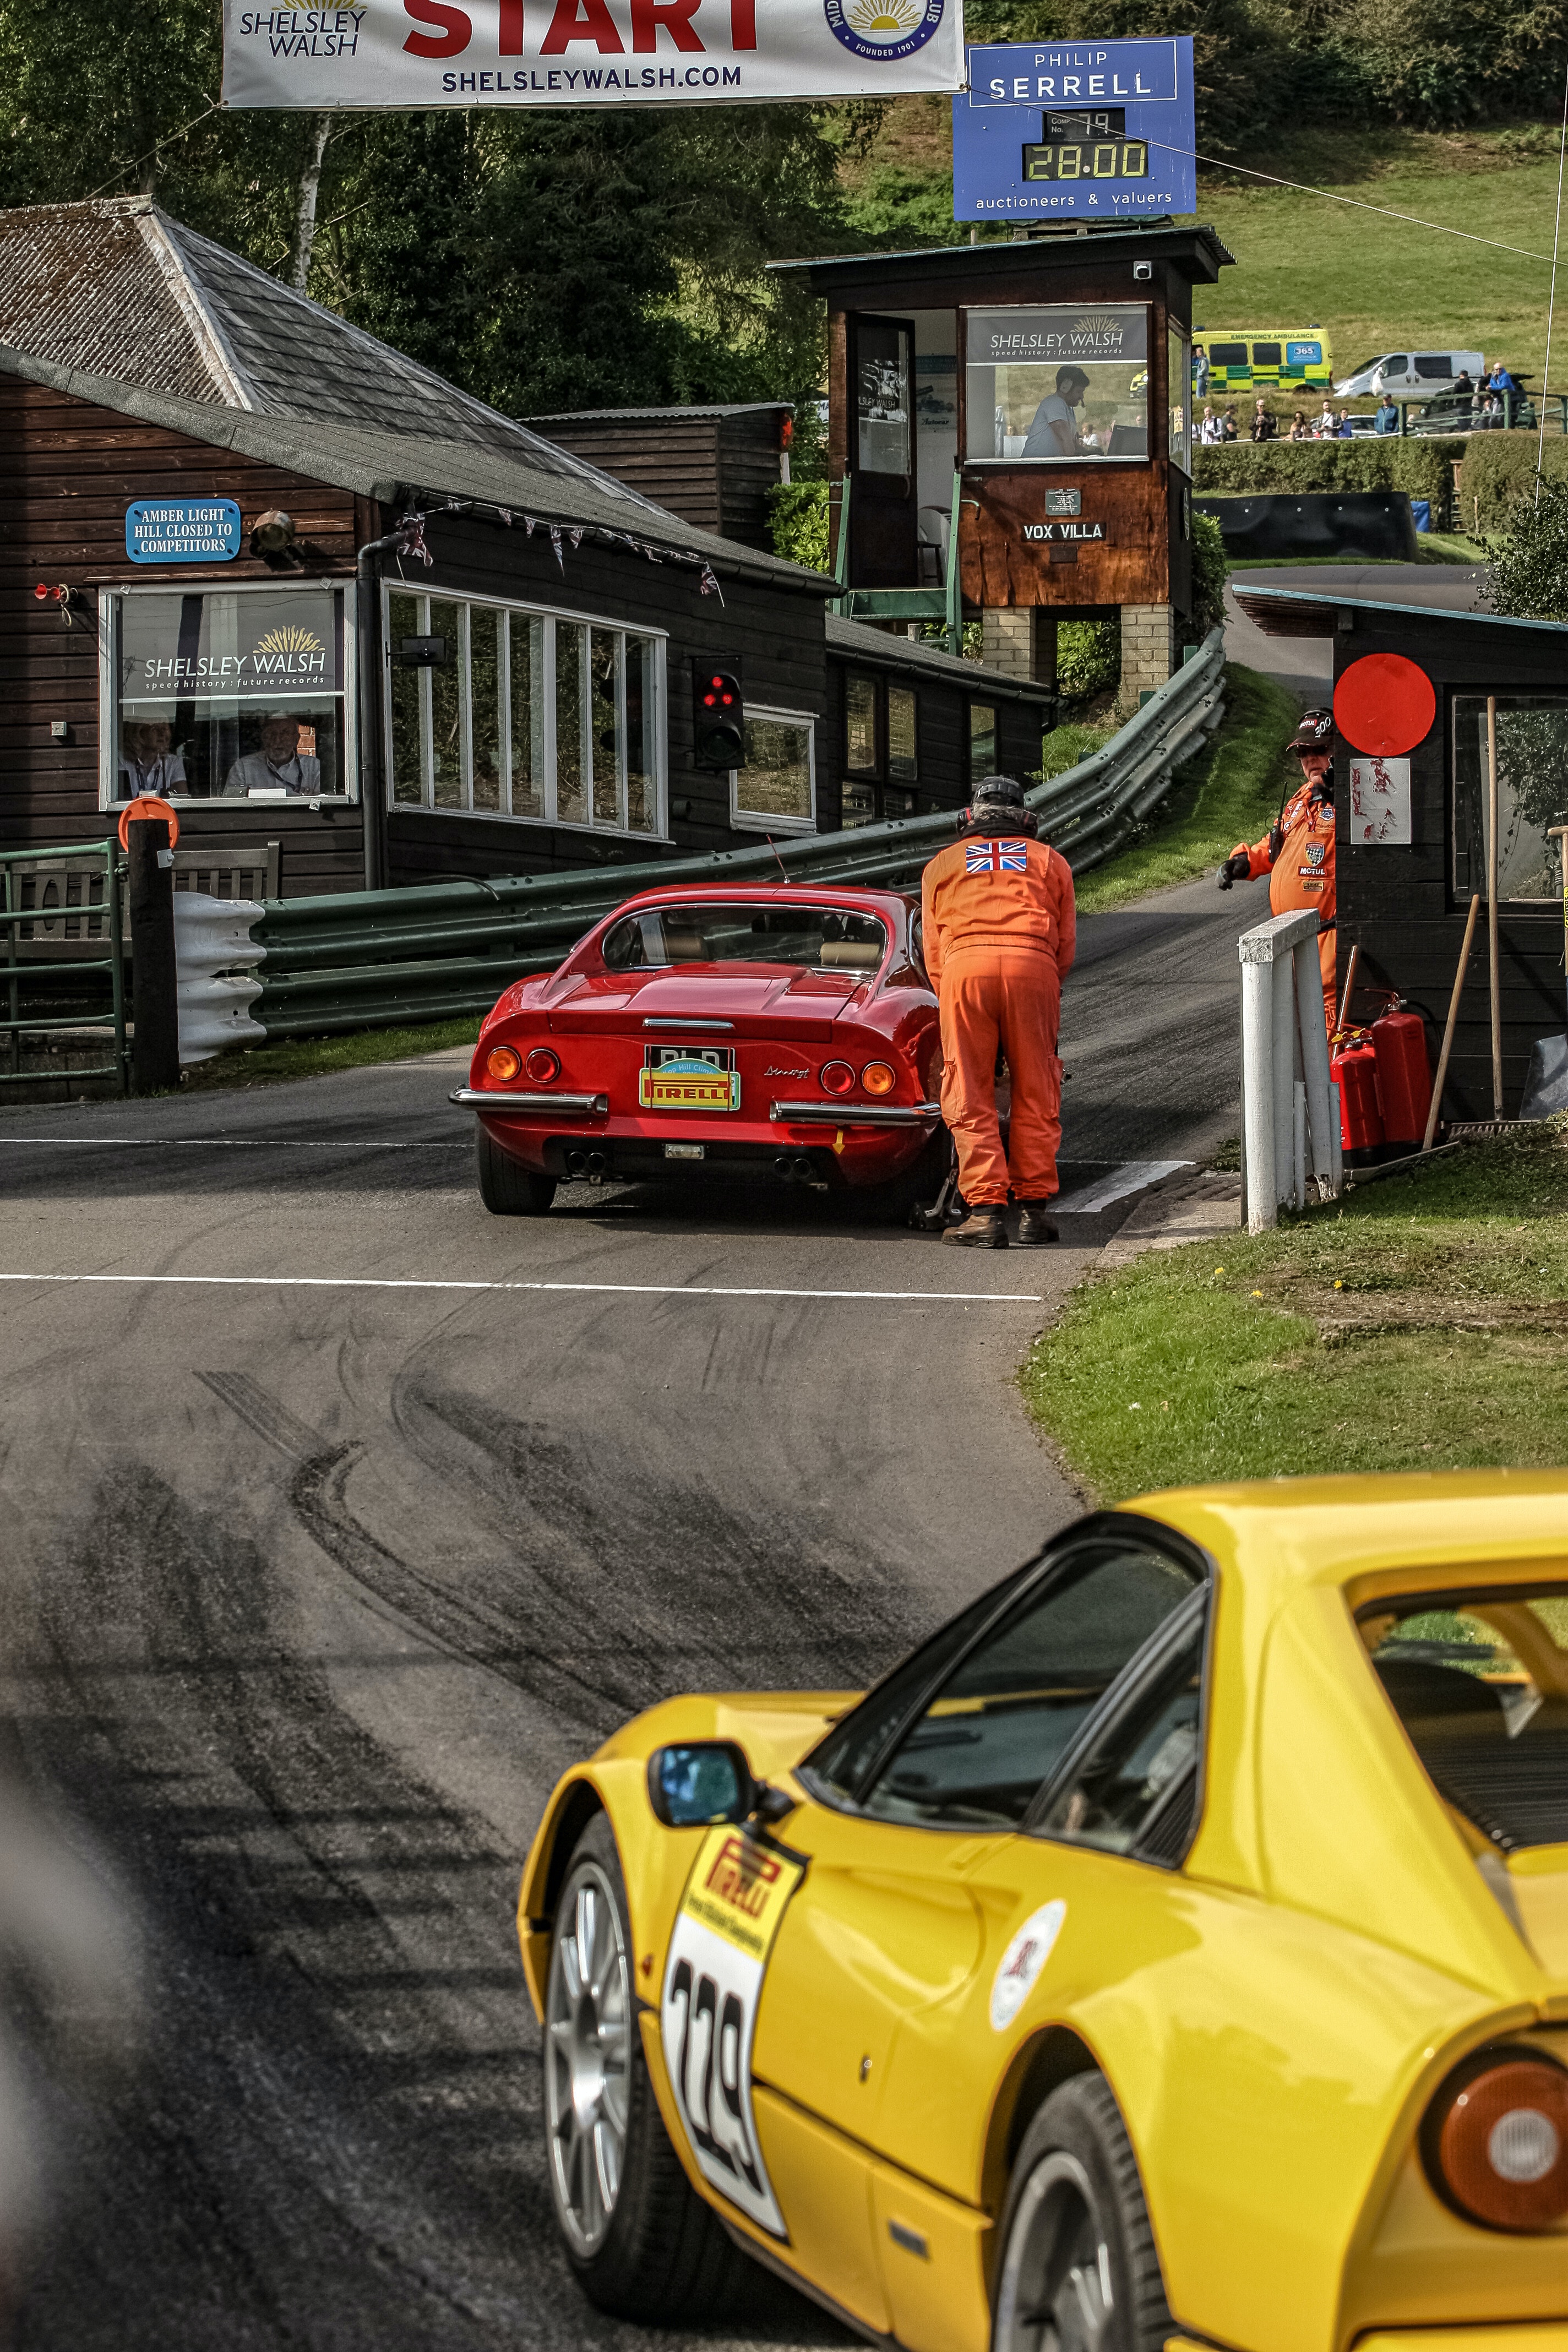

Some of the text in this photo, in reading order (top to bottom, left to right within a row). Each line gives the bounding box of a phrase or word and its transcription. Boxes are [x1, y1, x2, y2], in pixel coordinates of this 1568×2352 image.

[239, 10, 367, 35] SHELSLEY
[268, 33, 359, 58] WALSH
[856, 41, 915, 56] FOUNDED 1901
[1035, 52, 1107, 67] PHILIP
[442, 66, 741, 92] SHELSLEYWALSH.COM
[990, 73, 1151, 99] SERRELL
[1079, 113, 1109, 135] 79
[1029, 144, 1145, 179] 28.00
[976, 192, 1172, 209] auctioneers & valuers
[990, 332, 1124, 348] SHELSLEY WALSH
[141, 509, 225, 522] AMBER LIGHT
[134, 523, 232, 537] HILL CLOSED TO
[1023, 524, 1102, 539] VOX VILLA
[141, 538, 226, 553] COMPETITORS
[145, 653, 325, 678] SHELSLEY WALSH
[145, 680, 179, 690] speed
[184, 679, 226, 689] history
[237, 678, 275, 688] future
[279, 676, 324, 684] records
